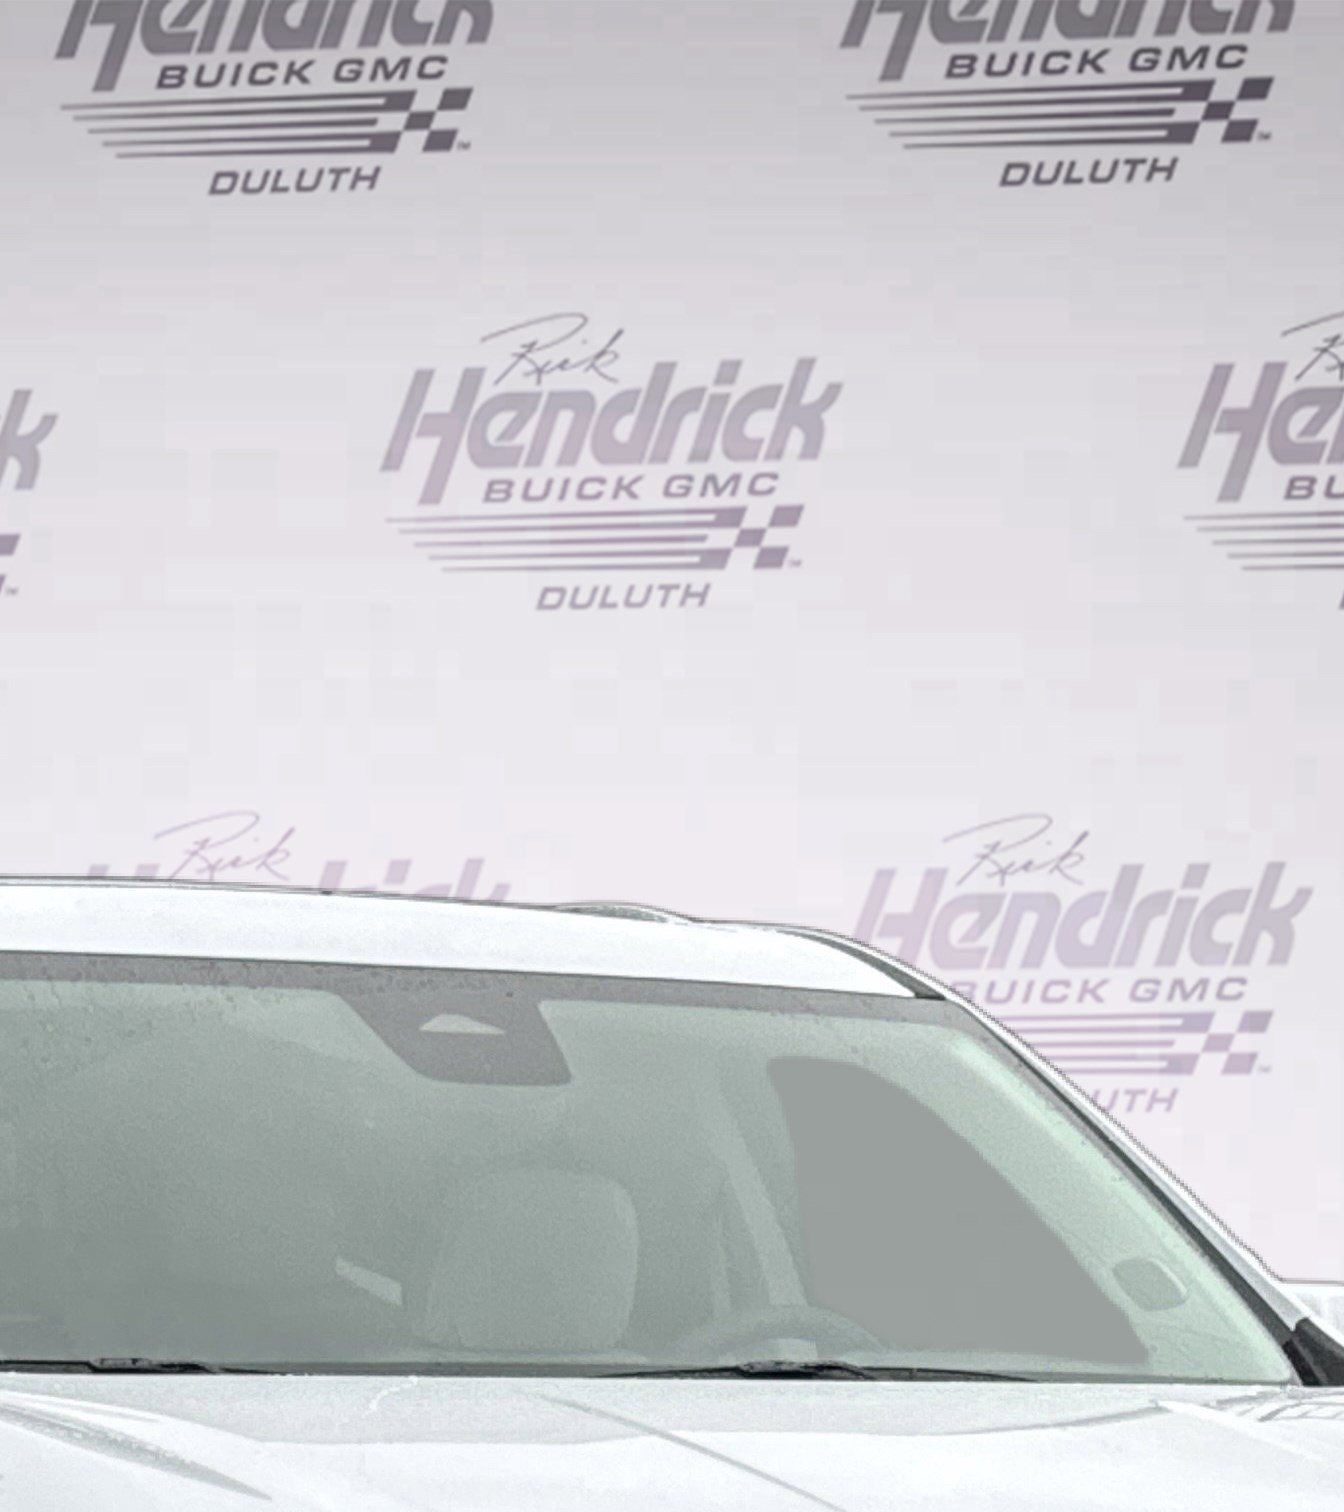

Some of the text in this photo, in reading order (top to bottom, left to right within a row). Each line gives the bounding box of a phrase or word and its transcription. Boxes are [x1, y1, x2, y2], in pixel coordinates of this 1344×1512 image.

[155, 55, 449, 90] BUICK GMC
[944, 43, 1248, 79] BUICK GMC
[208, 165, 382, 196] DULUTH
[999, 156, 1179, 187] DULUTH
[379, 356, 844, 506] Hendrick
[482, 471, 780, 504] BUICK GMC
[535, 582, 712, 611] DULUTH
[854, 861, 1314, 971] Hendrick
[1128, 976, 1248, 1003] GMC
